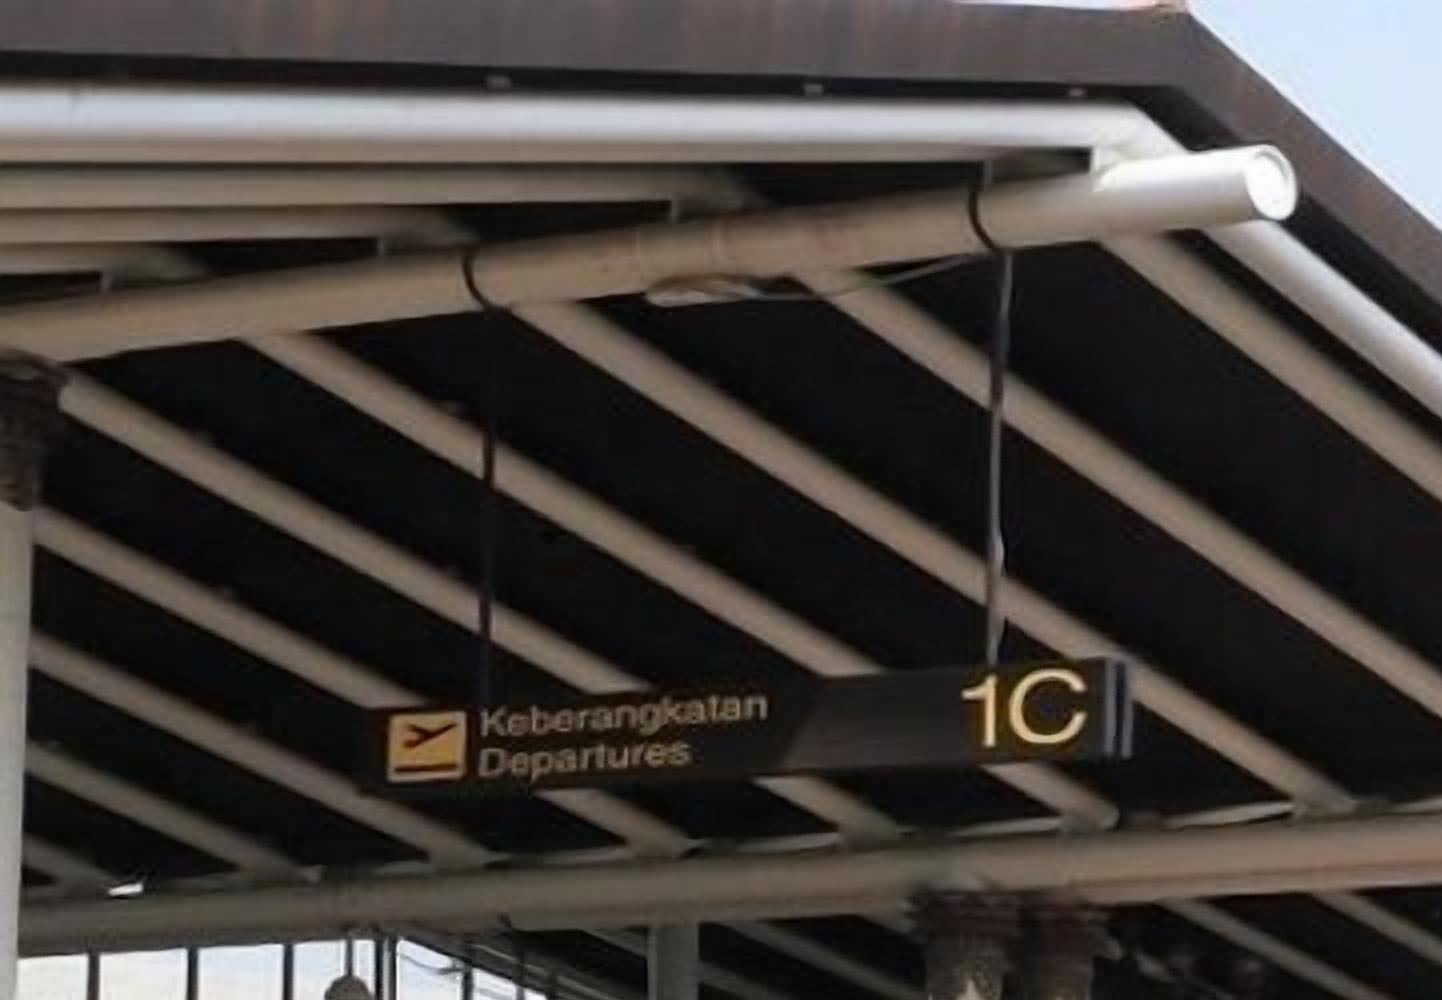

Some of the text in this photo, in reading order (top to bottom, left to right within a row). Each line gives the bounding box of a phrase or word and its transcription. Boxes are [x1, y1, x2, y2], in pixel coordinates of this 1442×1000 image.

[479, 694, 769, 737] Keberangkatan
[961, 668, 1087, 747] 1C
[479, 739, 693, 783] Departures
